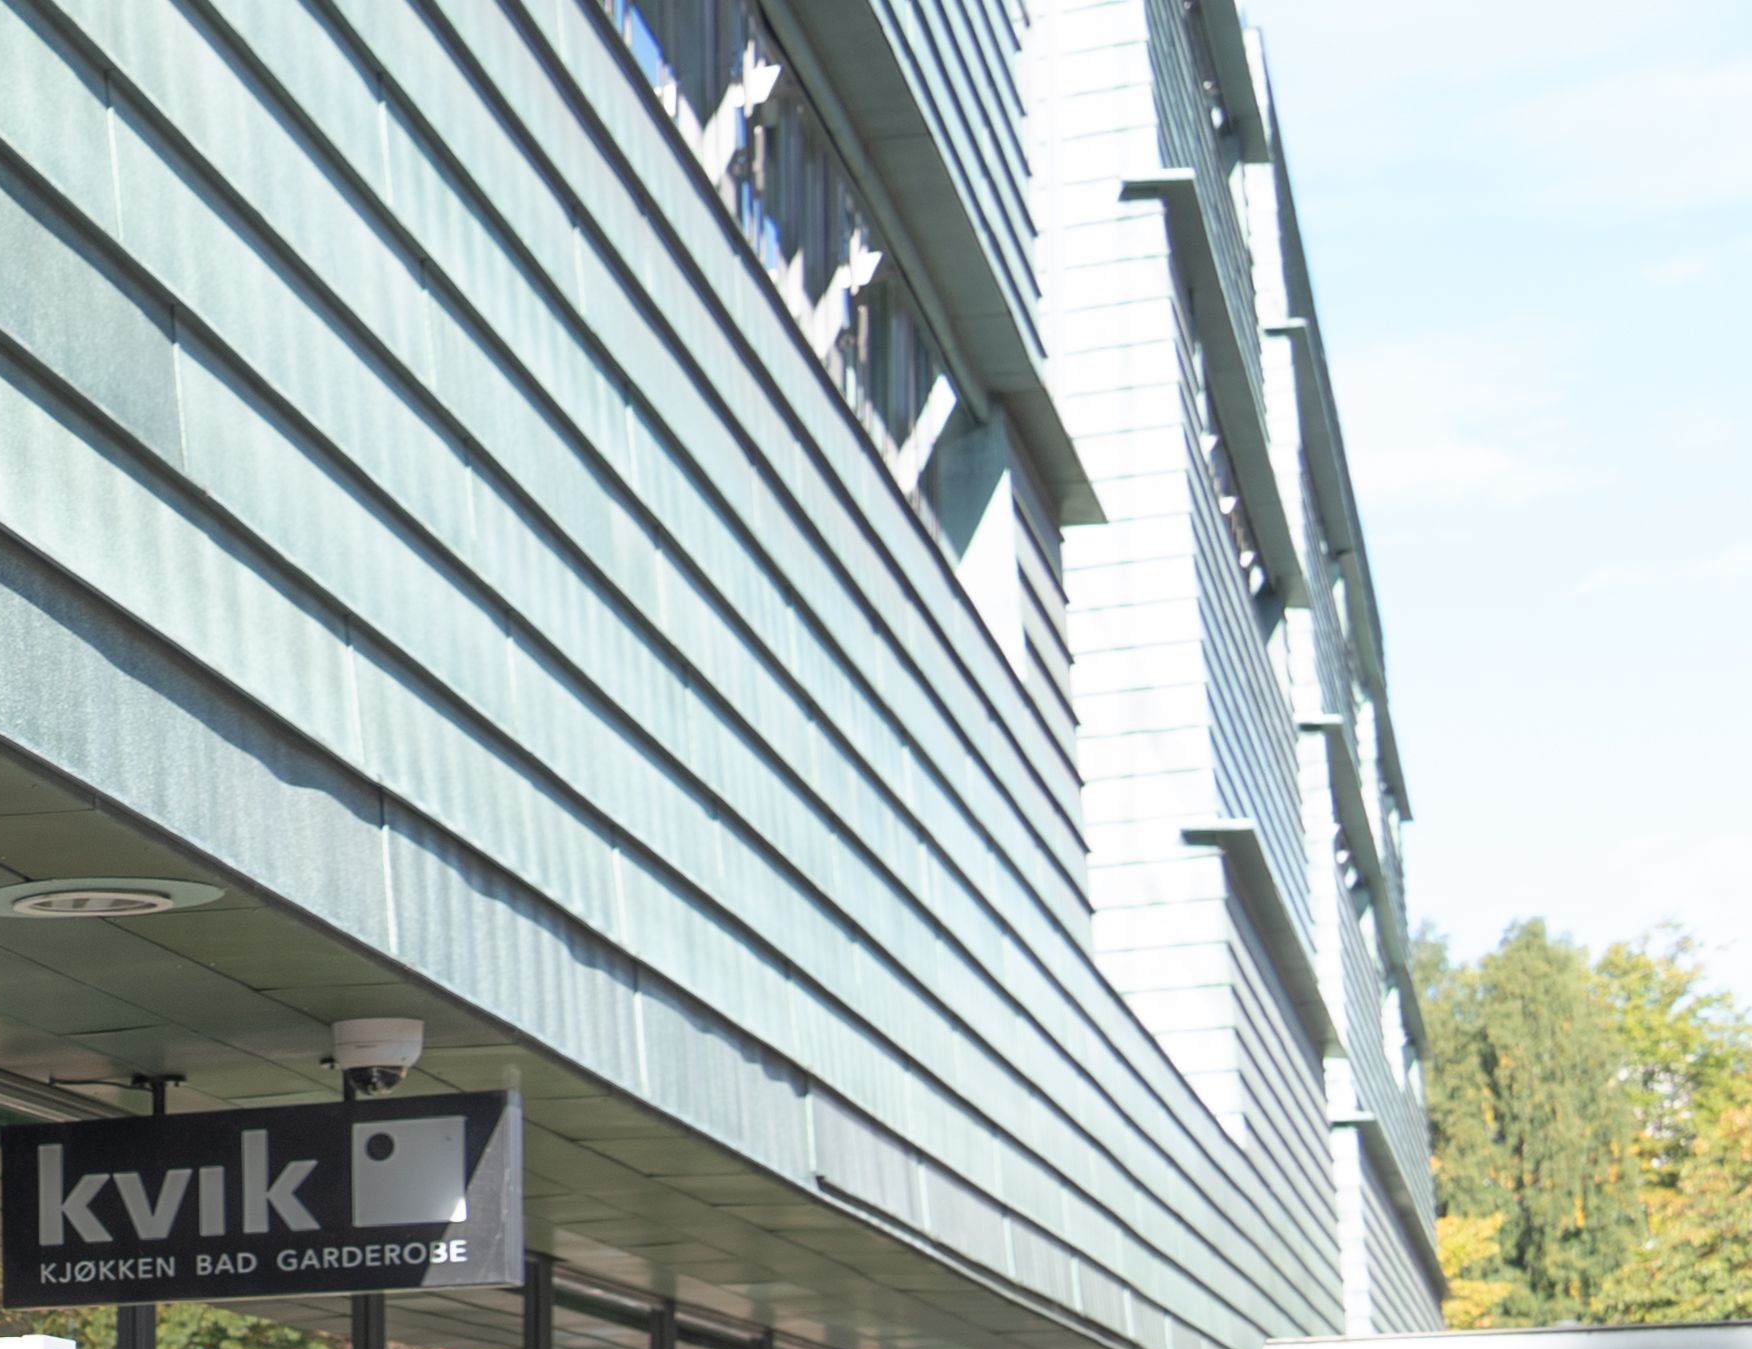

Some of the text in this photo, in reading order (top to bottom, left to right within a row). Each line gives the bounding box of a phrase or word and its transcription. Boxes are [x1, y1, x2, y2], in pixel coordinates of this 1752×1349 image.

[37, 1128, 321, 1246] kvik
[39, 1239, 468, 1285] KJØKKEN BAD GARDEROBE
